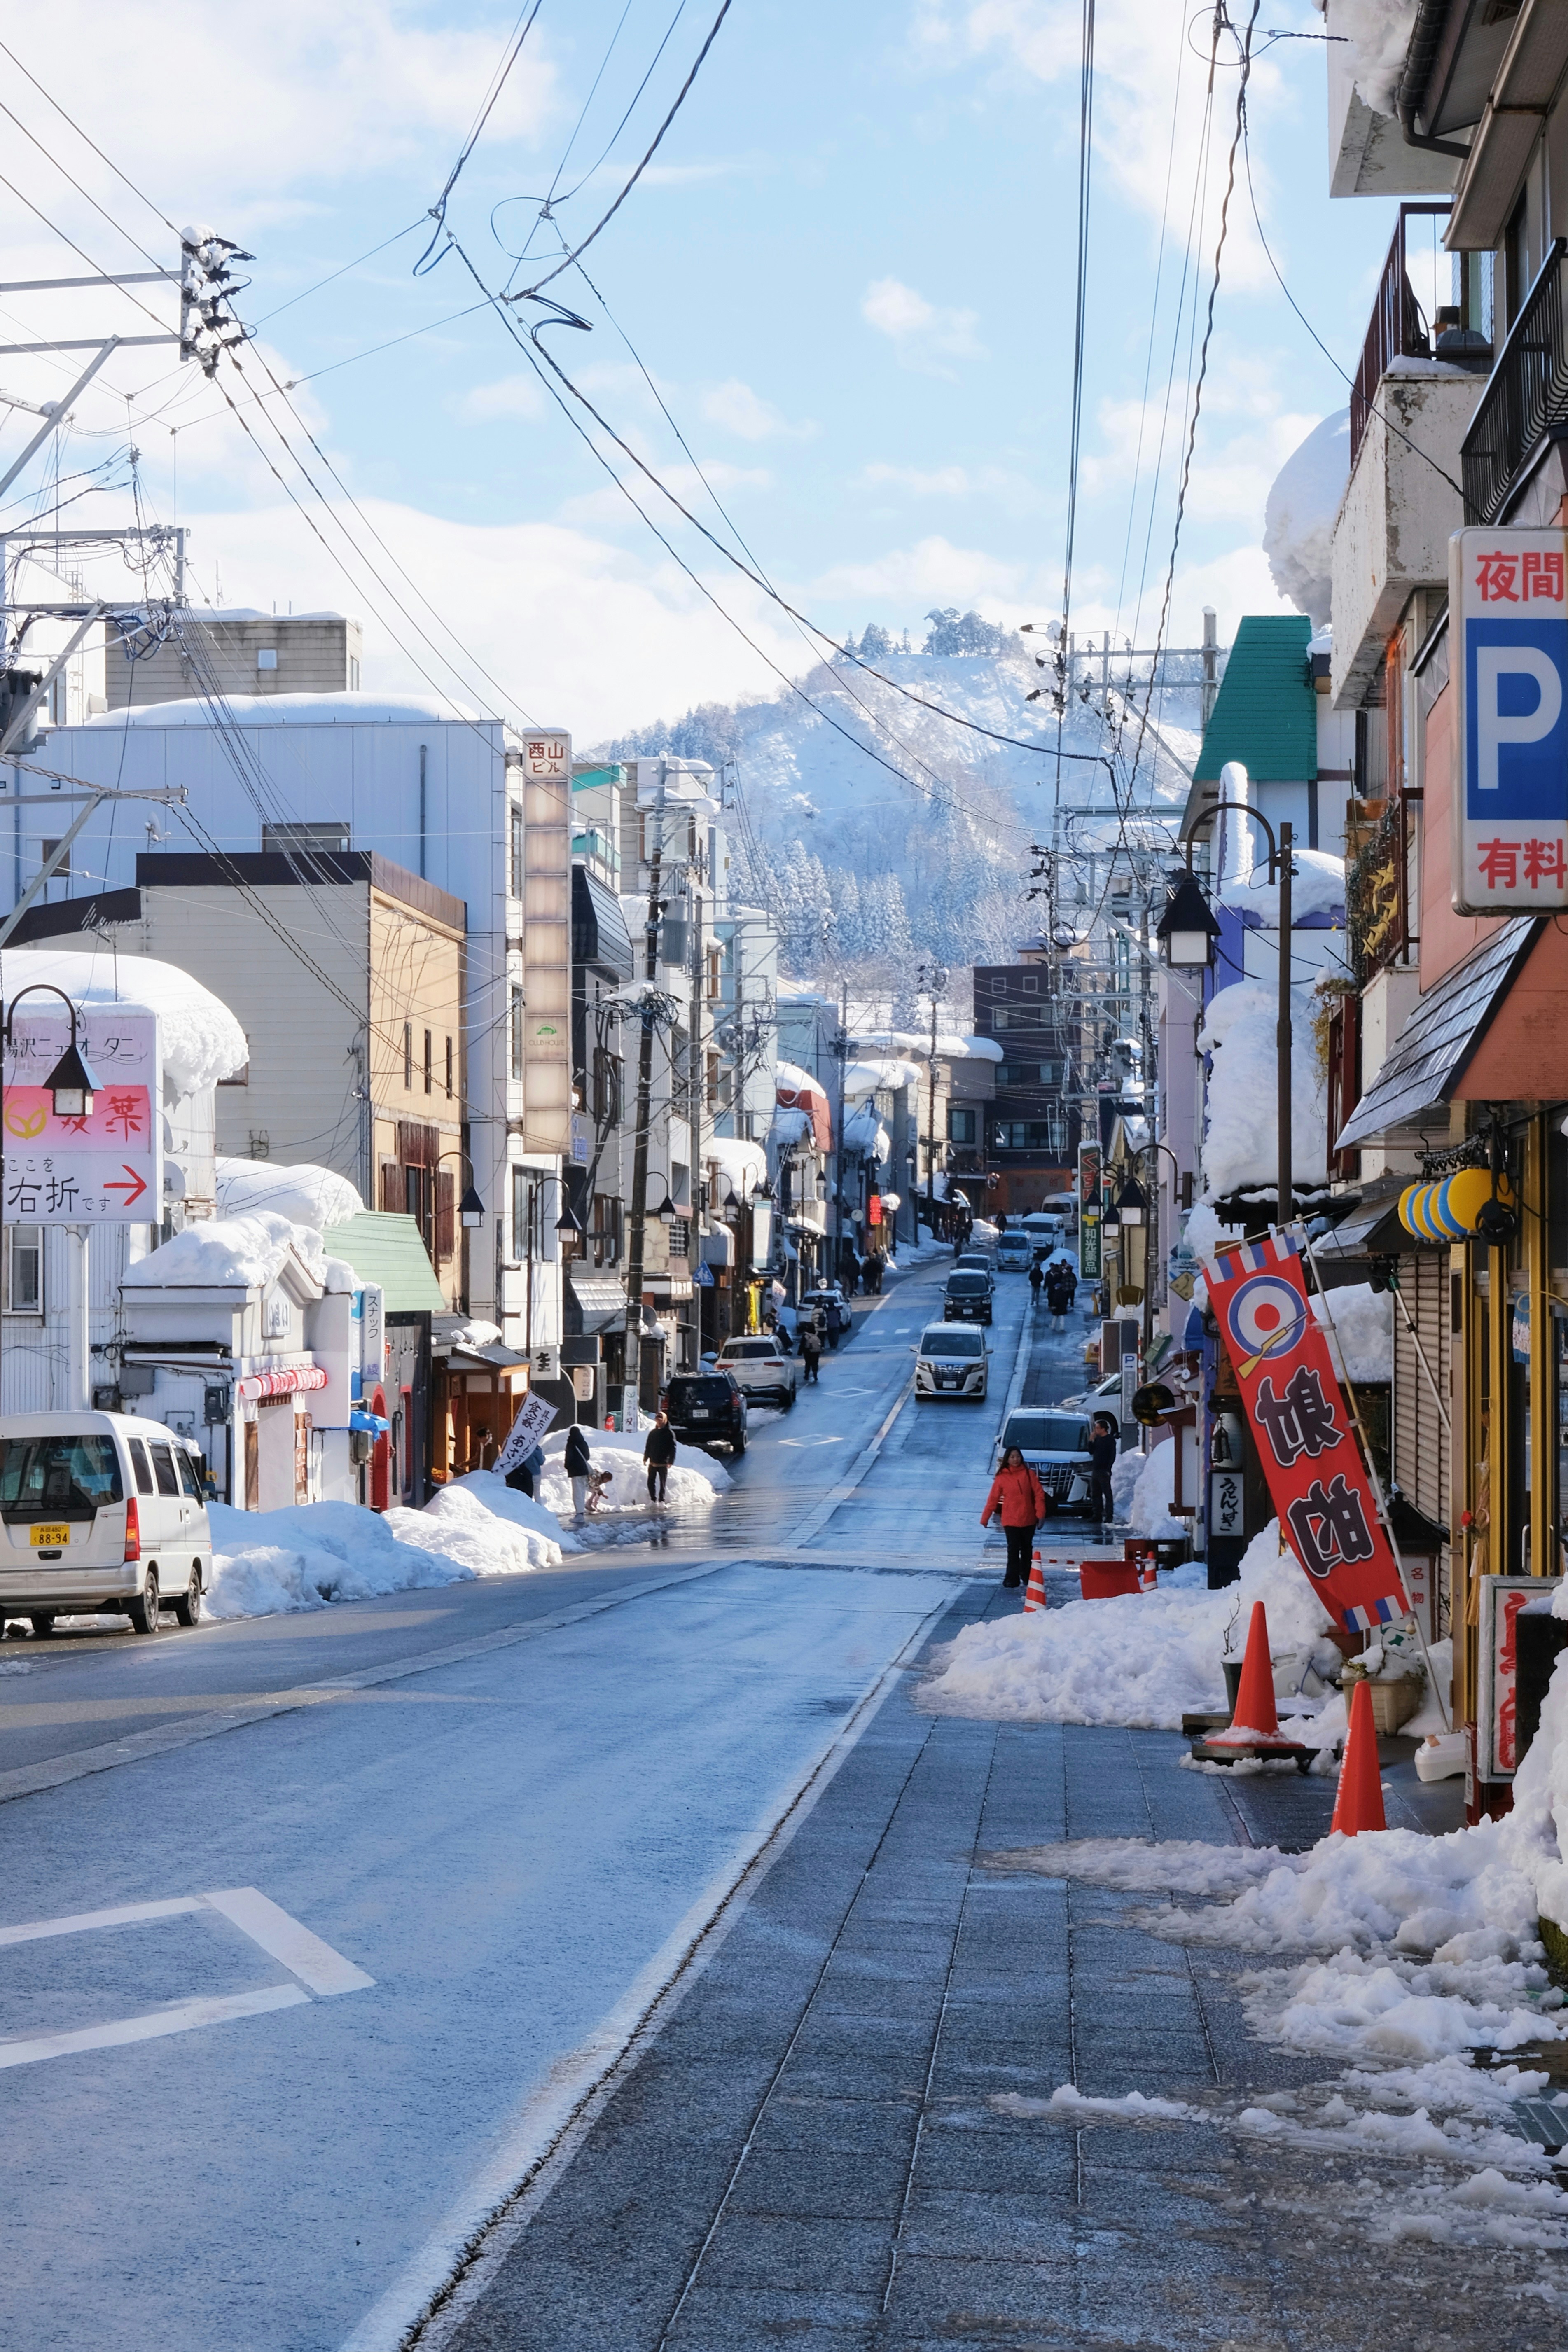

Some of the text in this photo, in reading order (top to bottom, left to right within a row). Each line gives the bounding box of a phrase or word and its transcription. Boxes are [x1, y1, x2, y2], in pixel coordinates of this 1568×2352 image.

[1477, 552, 1564, 603] 夜間
[1477, 646, 1563, 789] P
[528, 743, 563, 759] 西山
[533, 762, 561, 773] ビル
[1477, 838, 1568, 890] 有料
[9, 1158, 54, 1172] ここを
[1084, 1228, 1097, 1273] 和光薬品
[368, 1296, 378, 1338] スナック
[1125, 1355, 1135, 1364] P
[39, 1533, 68, 1544] 88-94
[1411, 1567, 1425, 1604] 名物
